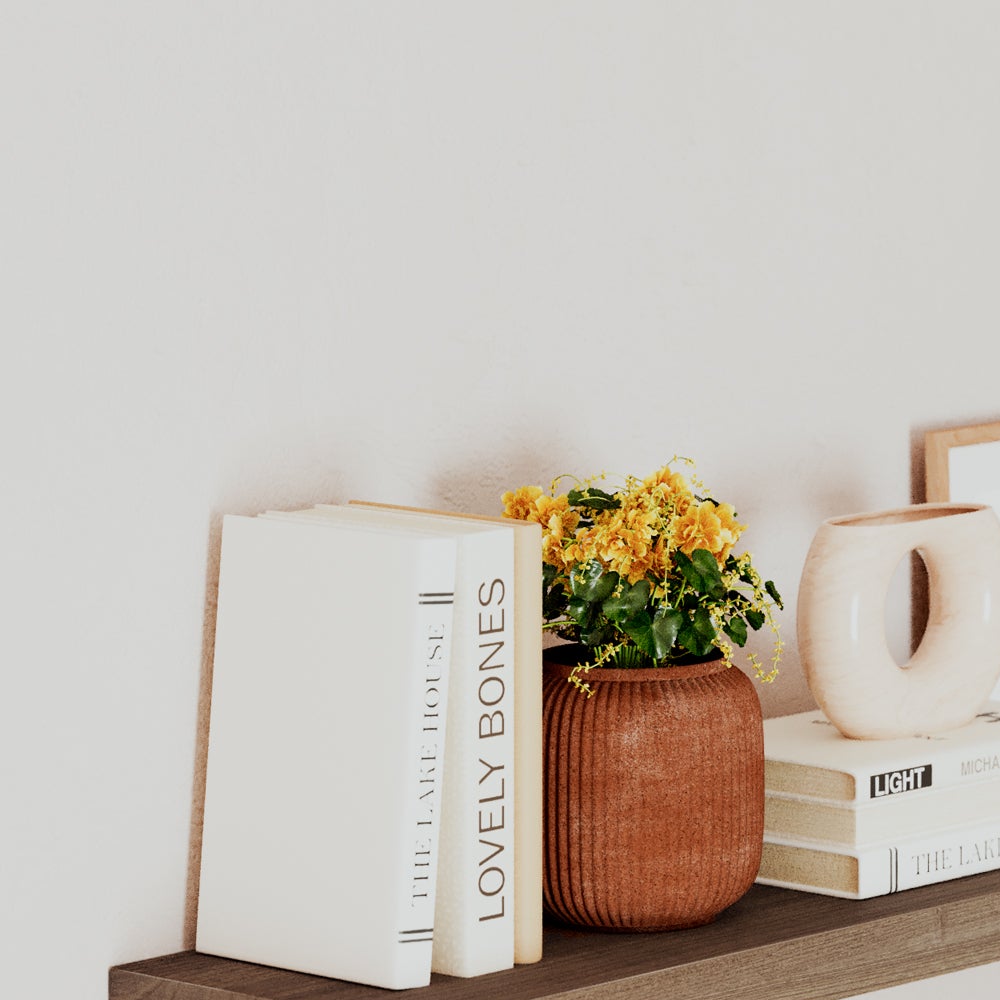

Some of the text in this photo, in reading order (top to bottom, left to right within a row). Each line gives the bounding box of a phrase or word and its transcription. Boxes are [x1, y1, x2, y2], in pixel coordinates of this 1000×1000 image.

[411, 623, 445, 907] THE LAKE HOUSE
[478, 577, 505, 922] LOVELY BONES
[874, 767, 925, 797] LIGHT
[912, 850, 952, 875] THE
